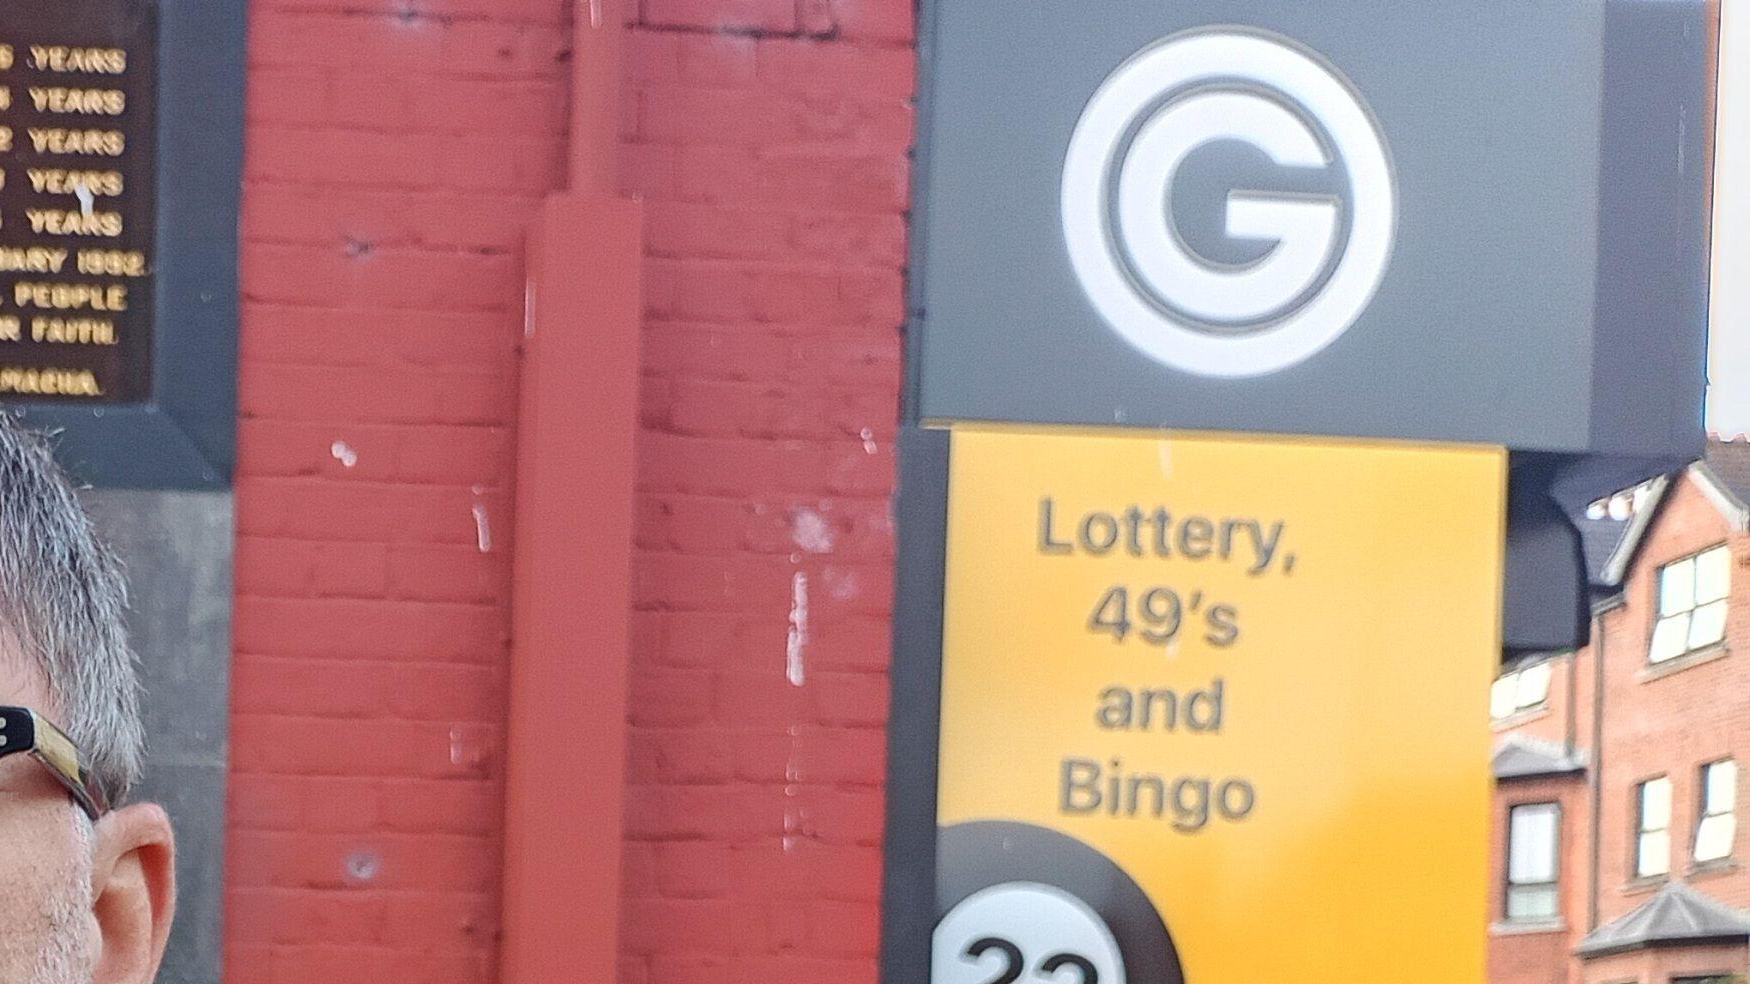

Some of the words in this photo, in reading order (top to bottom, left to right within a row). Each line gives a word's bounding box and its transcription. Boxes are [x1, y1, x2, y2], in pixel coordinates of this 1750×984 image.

[30, 45, 127, 75] YEARS
[29, 86, 126, 115] YEARS
[28, 126, 125, 157] YEARS
[27, 167, 124, 197] YEARS
[1117, 90, 1340, 322] G
[26, 207, 123, 237] YEARS
[14, 282, 128, 311] PEOPLE
[1038, 496, 1297, 577] Lottery,
[1089, 587, 1240, 647] 49's
[1095, 679, 1225, 733] and
[1060, 758, 1256, 835] Bingo
